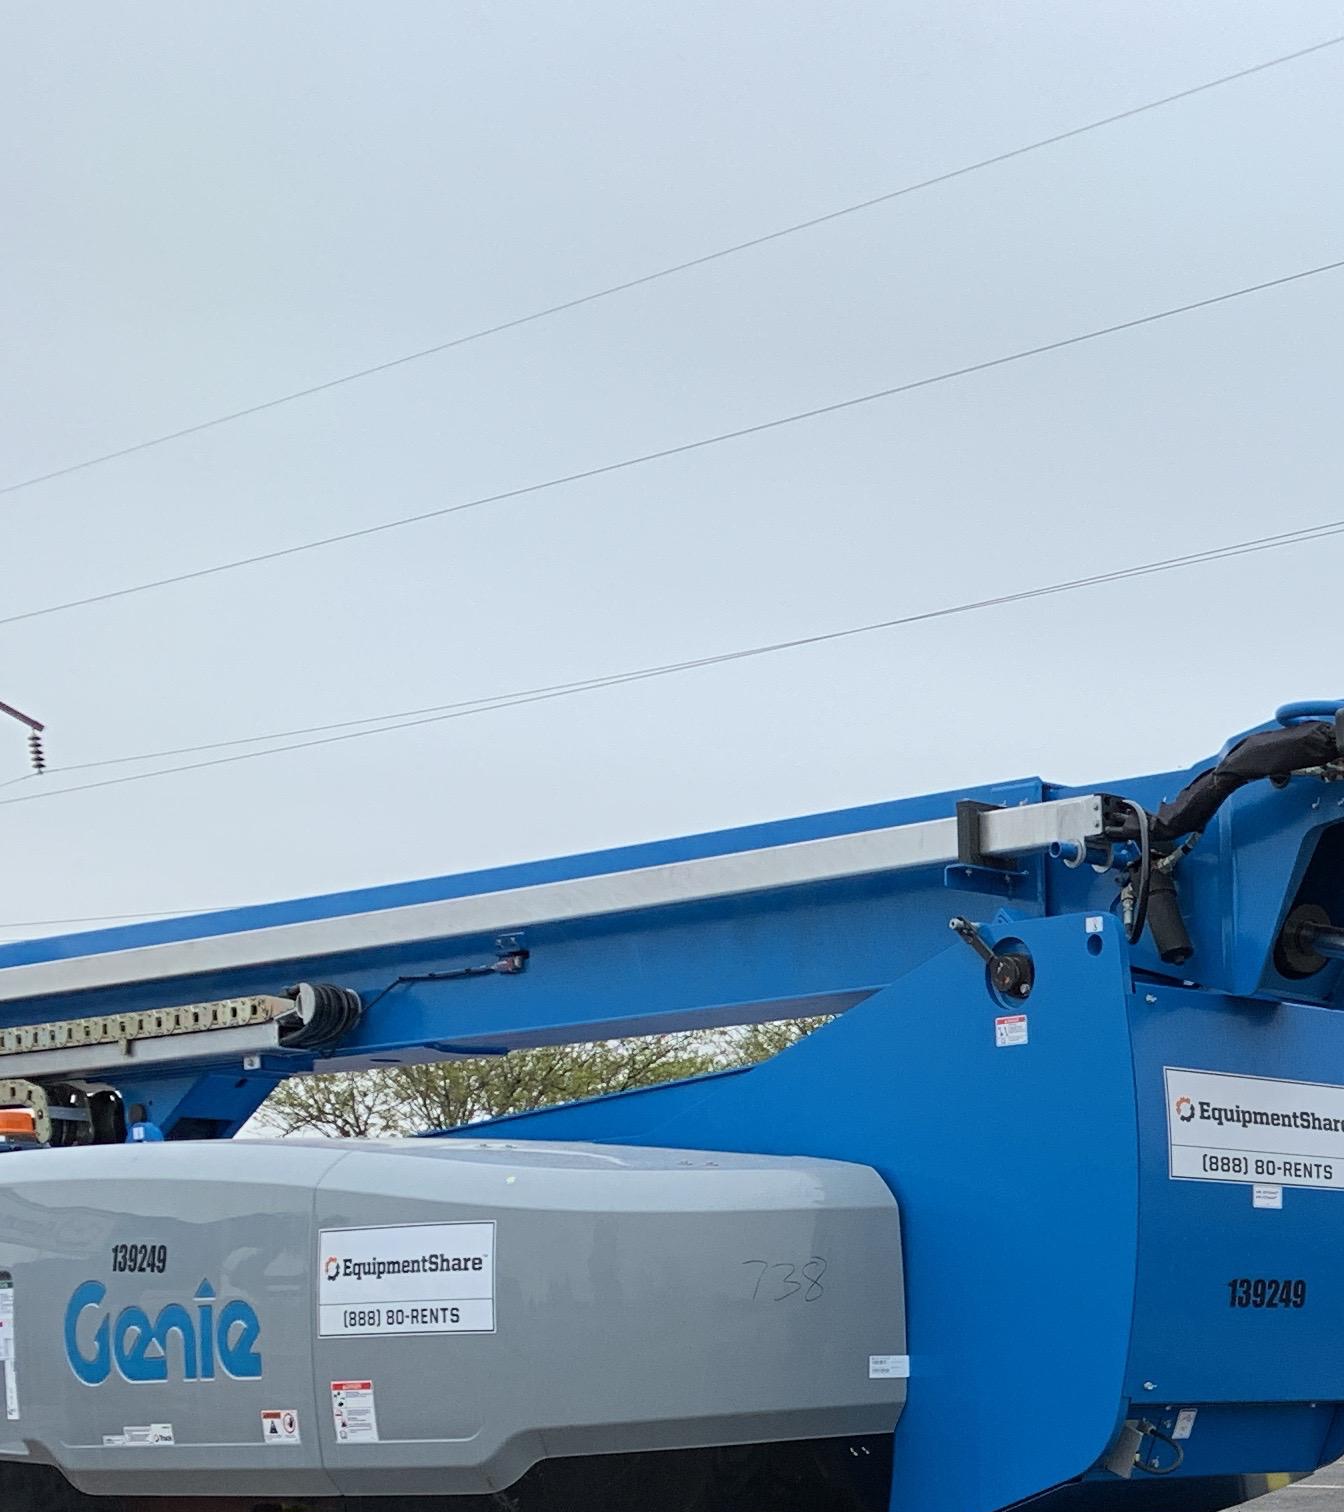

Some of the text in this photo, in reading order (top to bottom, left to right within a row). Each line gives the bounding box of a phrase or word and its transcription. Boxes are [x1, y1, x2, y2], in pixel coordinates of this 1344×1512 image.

[1203, 1153, 1333, 1180] (888) 80-RENTS
[111, 1244, 167, 1274] 139249
[342, 1253, 483, 1280] EquipmentShare
[1228, 1278, 1306, 1308] 139249
[344, 1307, 460, 1328] (888) 80-RENTS
[64, 1277, 263, 1387] Genie
